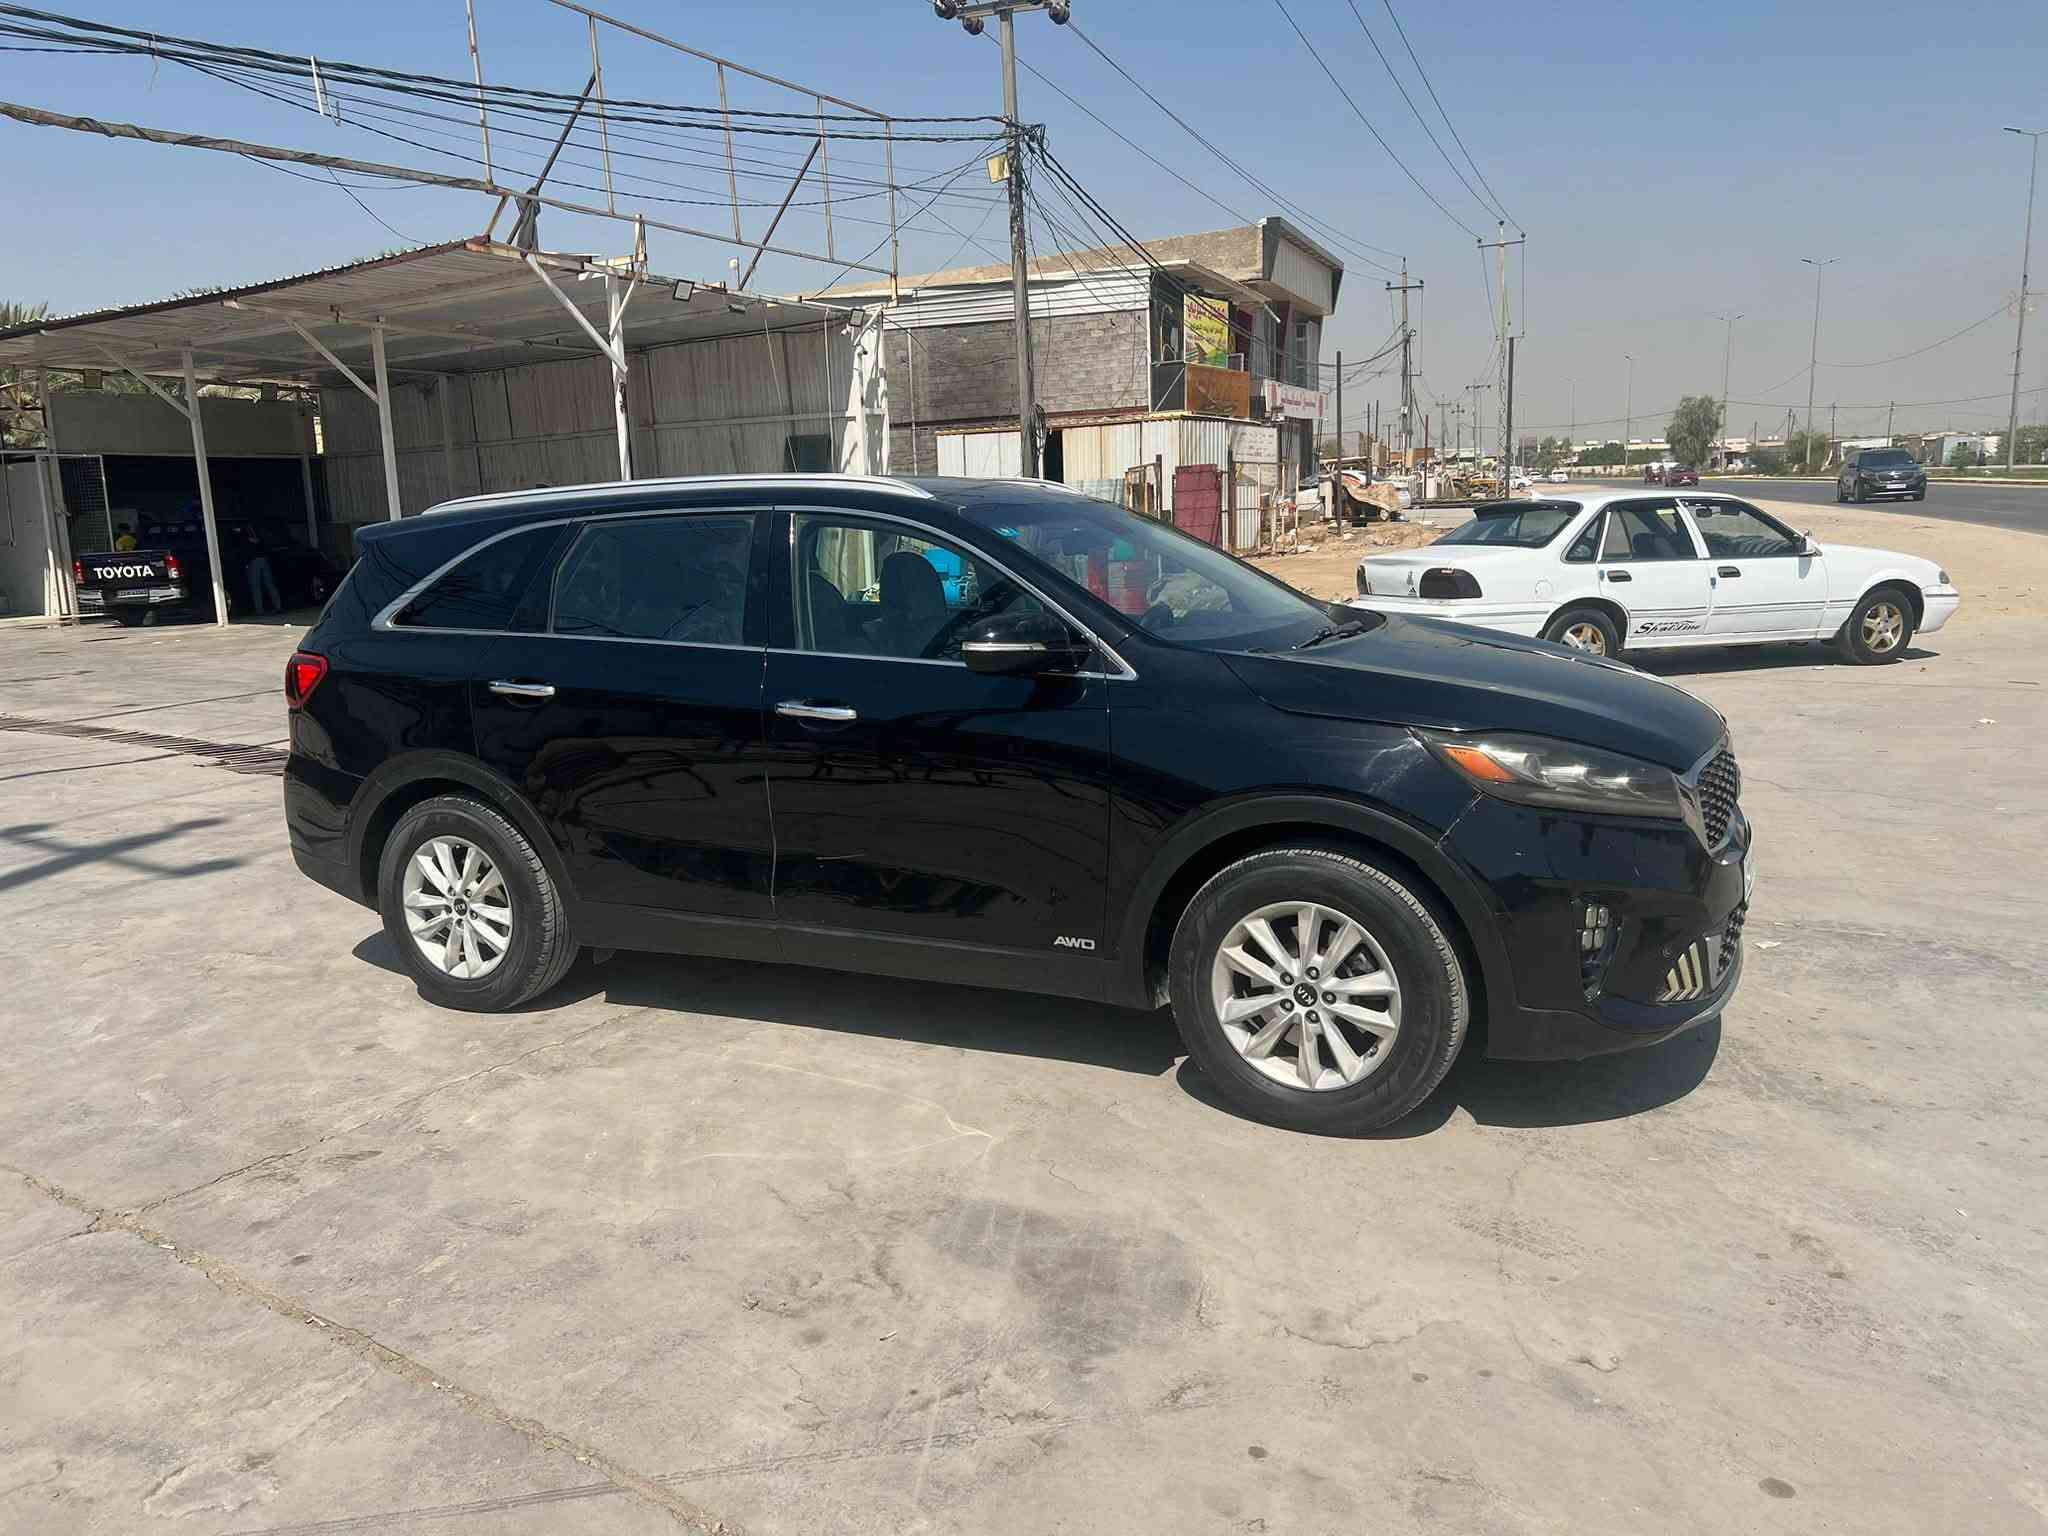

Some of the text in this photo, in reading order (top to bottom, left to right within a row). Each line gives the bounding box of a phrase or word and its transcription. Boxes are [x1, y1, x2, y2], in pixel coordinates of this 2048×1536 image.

[93, 565, 154, 580] TOYOTA
[1054, 935, 1096, 950] AWD
[1297, 985, 1315, 1005] KIA
